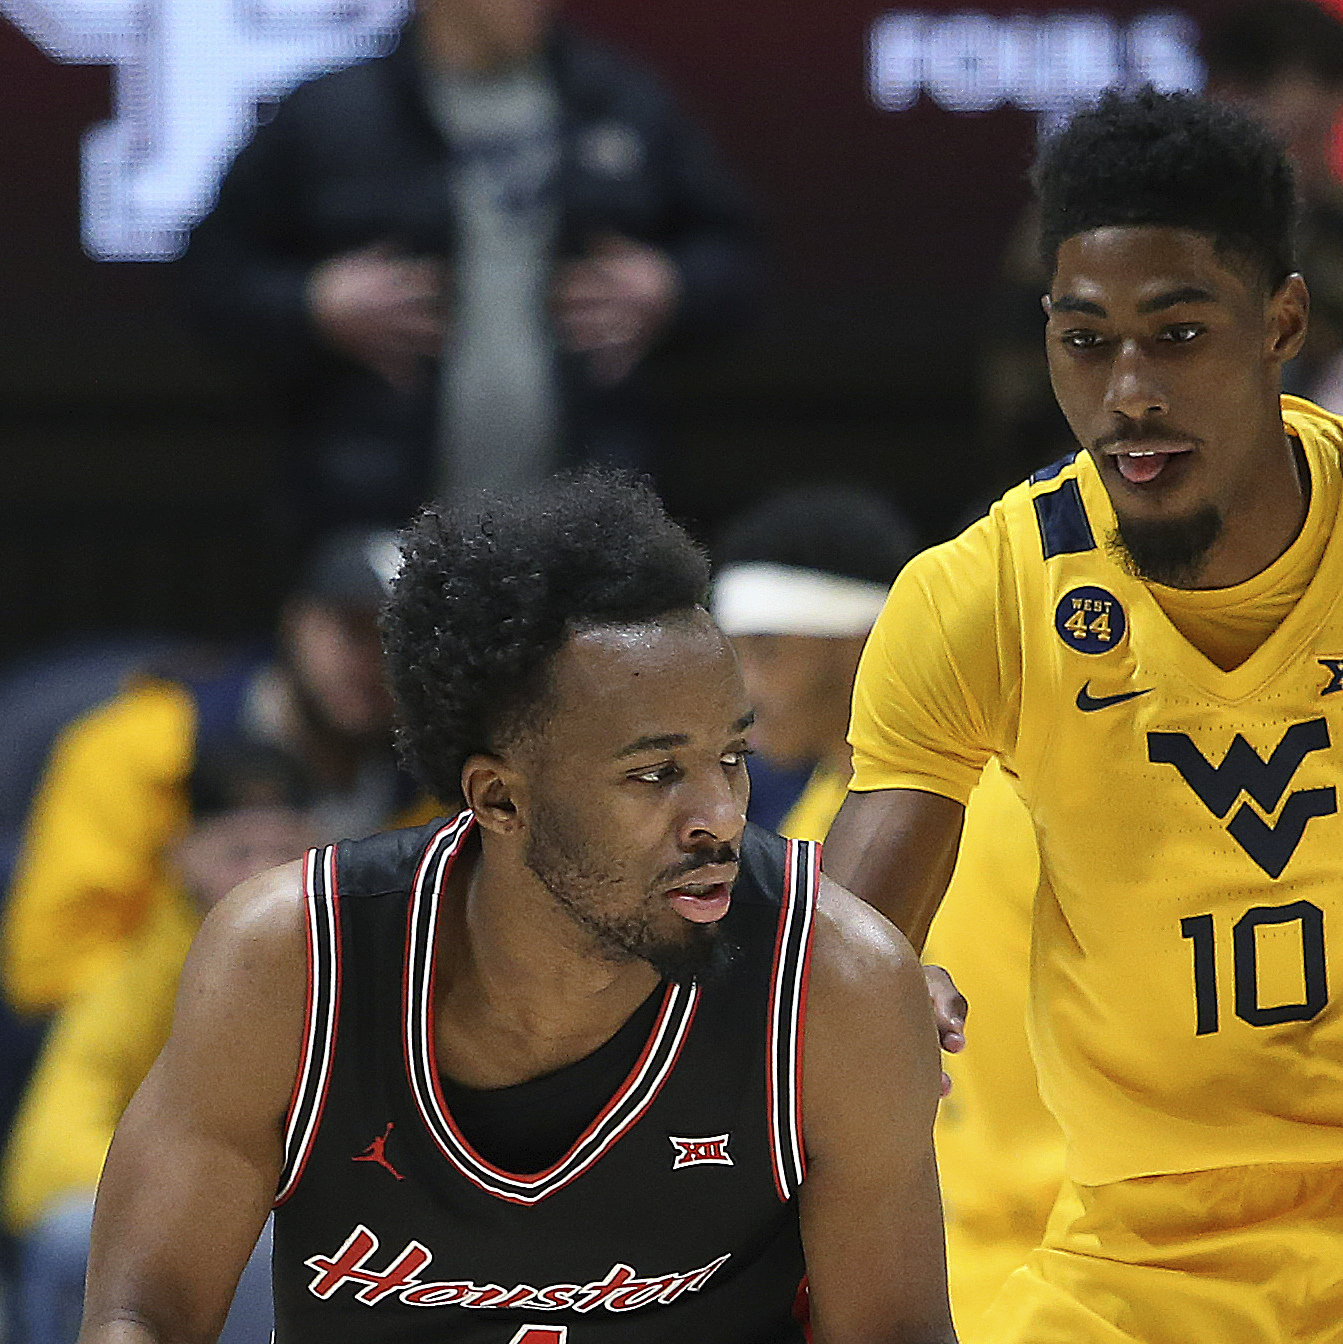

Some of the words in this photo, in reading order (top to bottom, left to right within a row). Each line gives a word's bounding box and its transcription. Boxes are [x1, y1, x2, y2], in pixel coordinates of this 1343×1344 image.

[1064, 610, 1112, 641] 44
[1071, 598, 1112, 613] WEST
[1179, 899, 1329, 1036] 10
[303, 1224, 731, 1312] Houston
